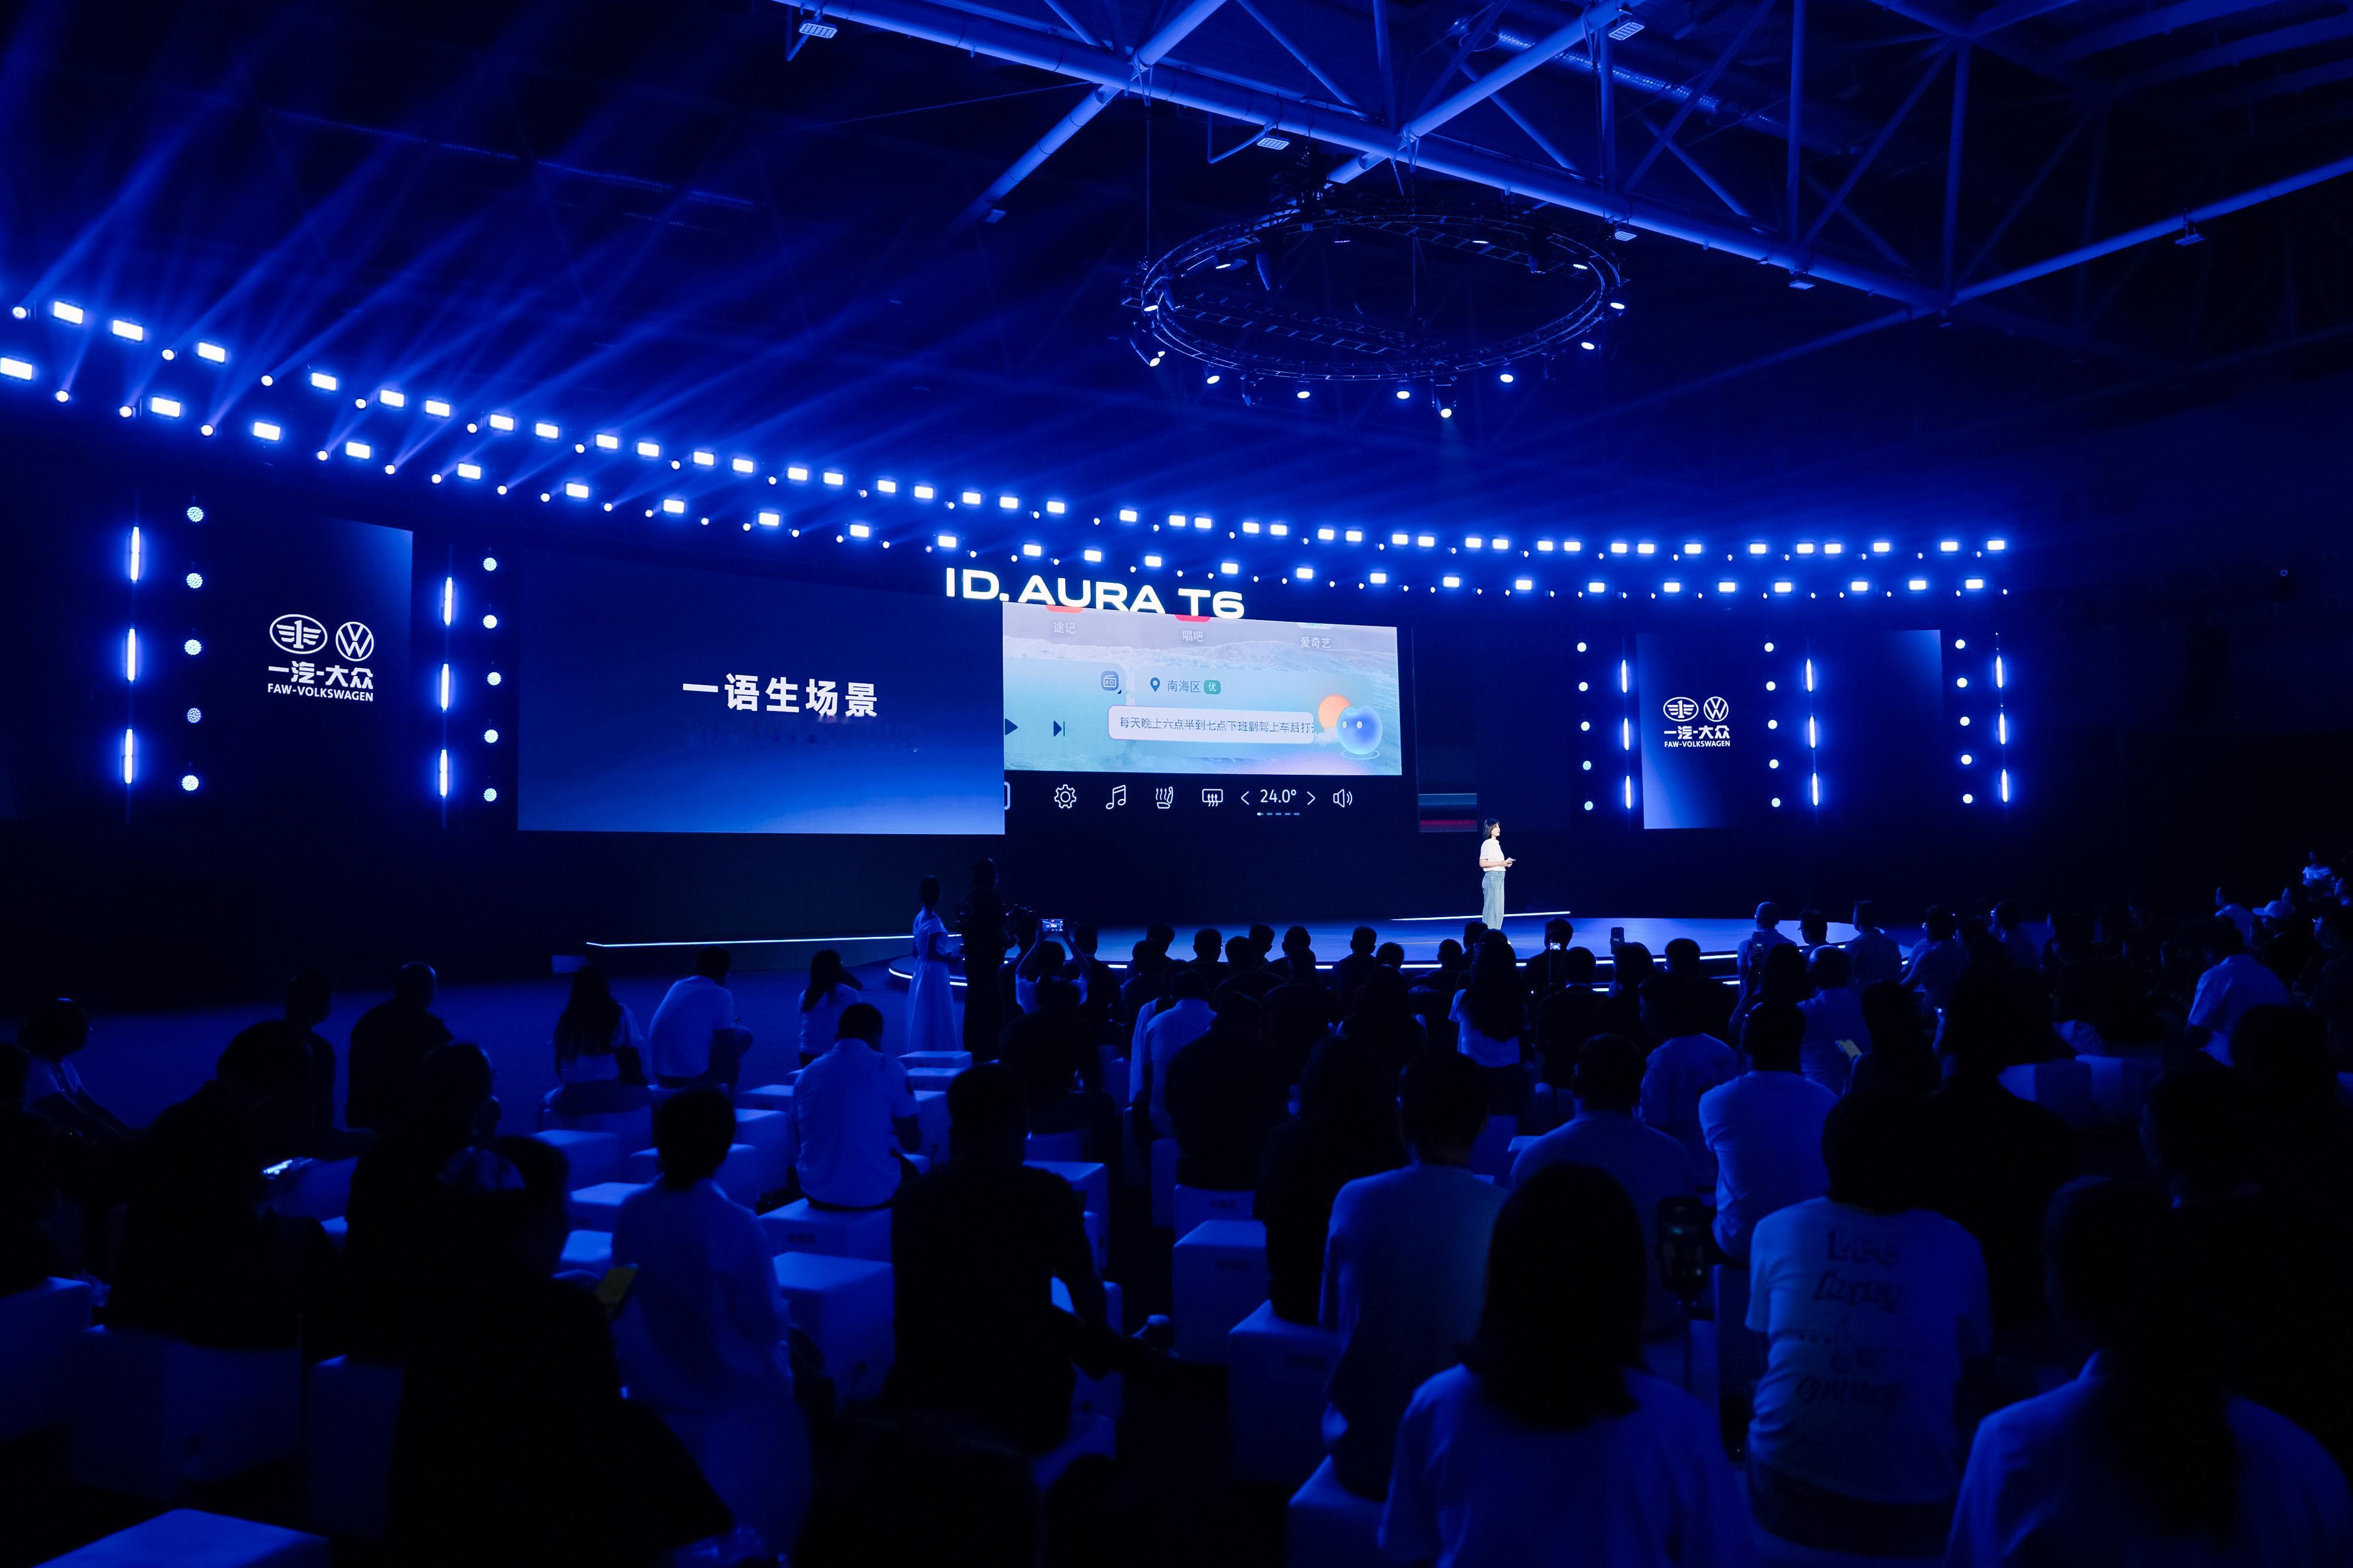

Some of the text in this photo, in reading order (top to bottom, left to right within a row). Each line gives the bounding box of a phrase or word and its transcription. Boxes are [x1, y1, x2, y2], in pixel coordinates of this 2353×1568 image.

[945, 567, 1245, 619] ID. AURA T6
[1053, 621, 1076, 635] 途记
[1182, 629, 1204, 642] 唱吧
[1300, 636, 1331, 648] 爱奇艺
[268, 660, 374, 690] 一汽-大众
[267, 683, 374, 702] FAW-VOLKSWAGEN
[1166, 679, 1217, 693] 南海区 优
[682, 672, 878, 718] 一语生场景
[1664, 725, 1730, 740] 一汽-大众
[1260, 788, 1297, 803] 24.0°
